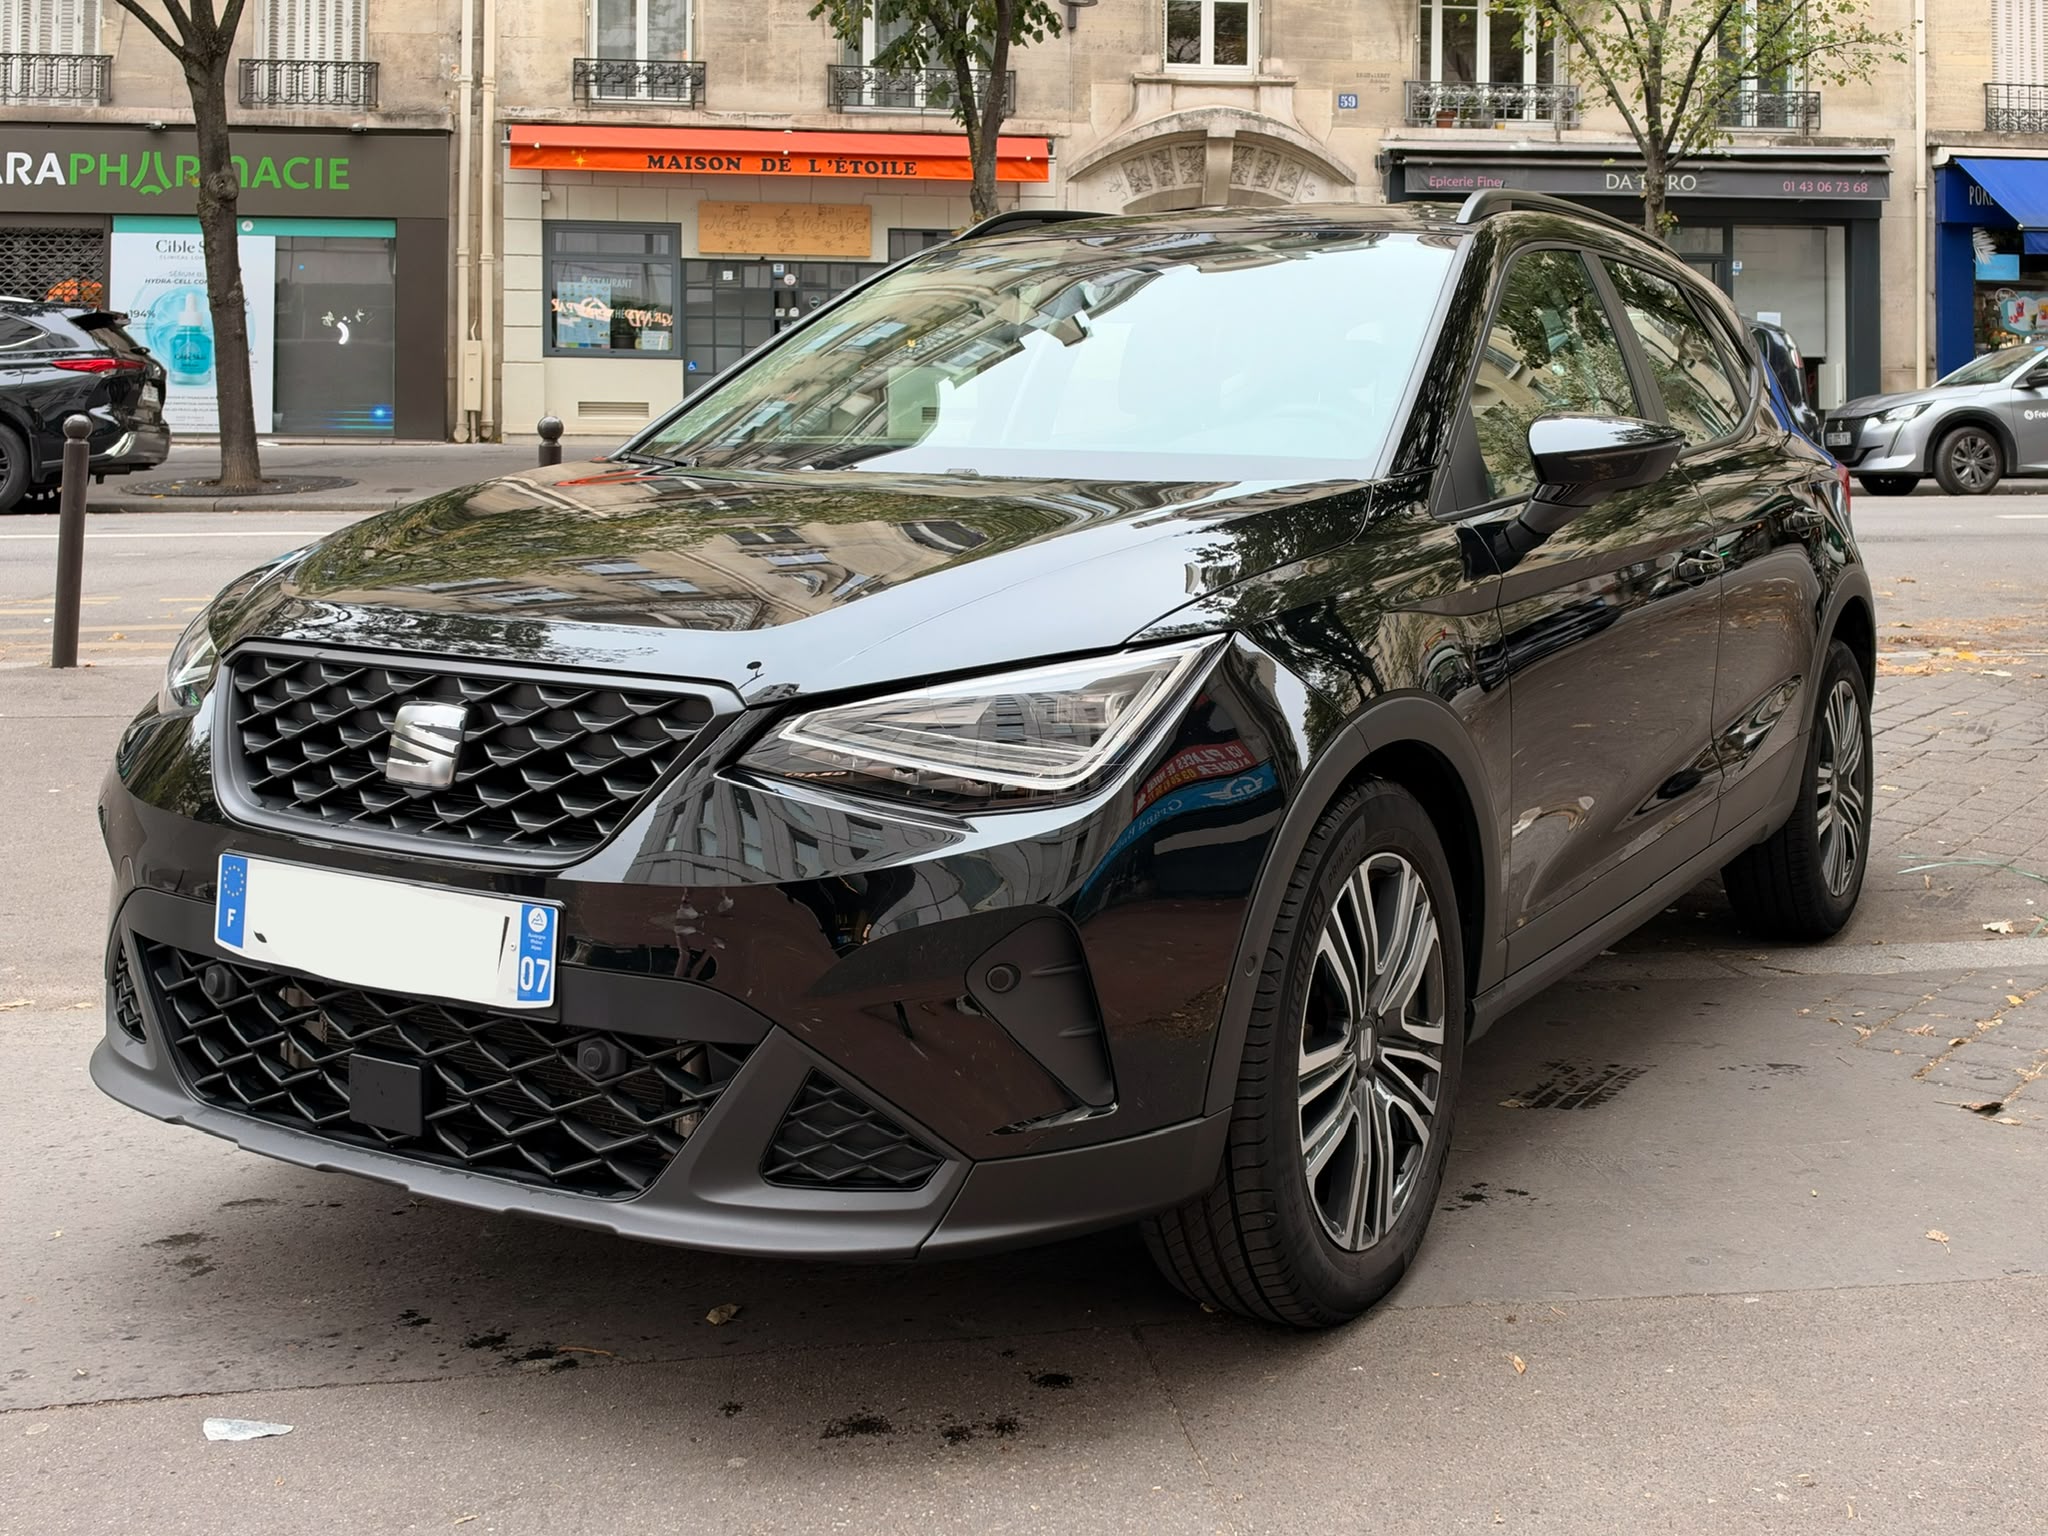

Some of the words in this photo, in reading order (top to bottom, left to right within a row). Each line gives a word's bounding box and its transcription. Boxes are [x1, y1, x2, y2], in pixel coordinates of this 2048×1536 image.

[1340, 95, 1357, 108] 59
[647, 155, 742, 171] MAISON
[761, 158, 792, 173] DE
[808, 156, 917, 176] L'ÉTOILE
[1429, 175, 1474, 188] Epicerie
[1605, 173, 1633, 190] DA
[1783, 181, 1795, 192] 01
[1799, 181, 1813, 192] 43
[1817, 182, 1832, 193] 06
[1836, 182, 1850, 193] 73
[1853, 182, 1868, 194] 68
[155, 239, 195, 253] Cible
[227, 908, 237, 927] F
[520, 955, 551, 993] 07
